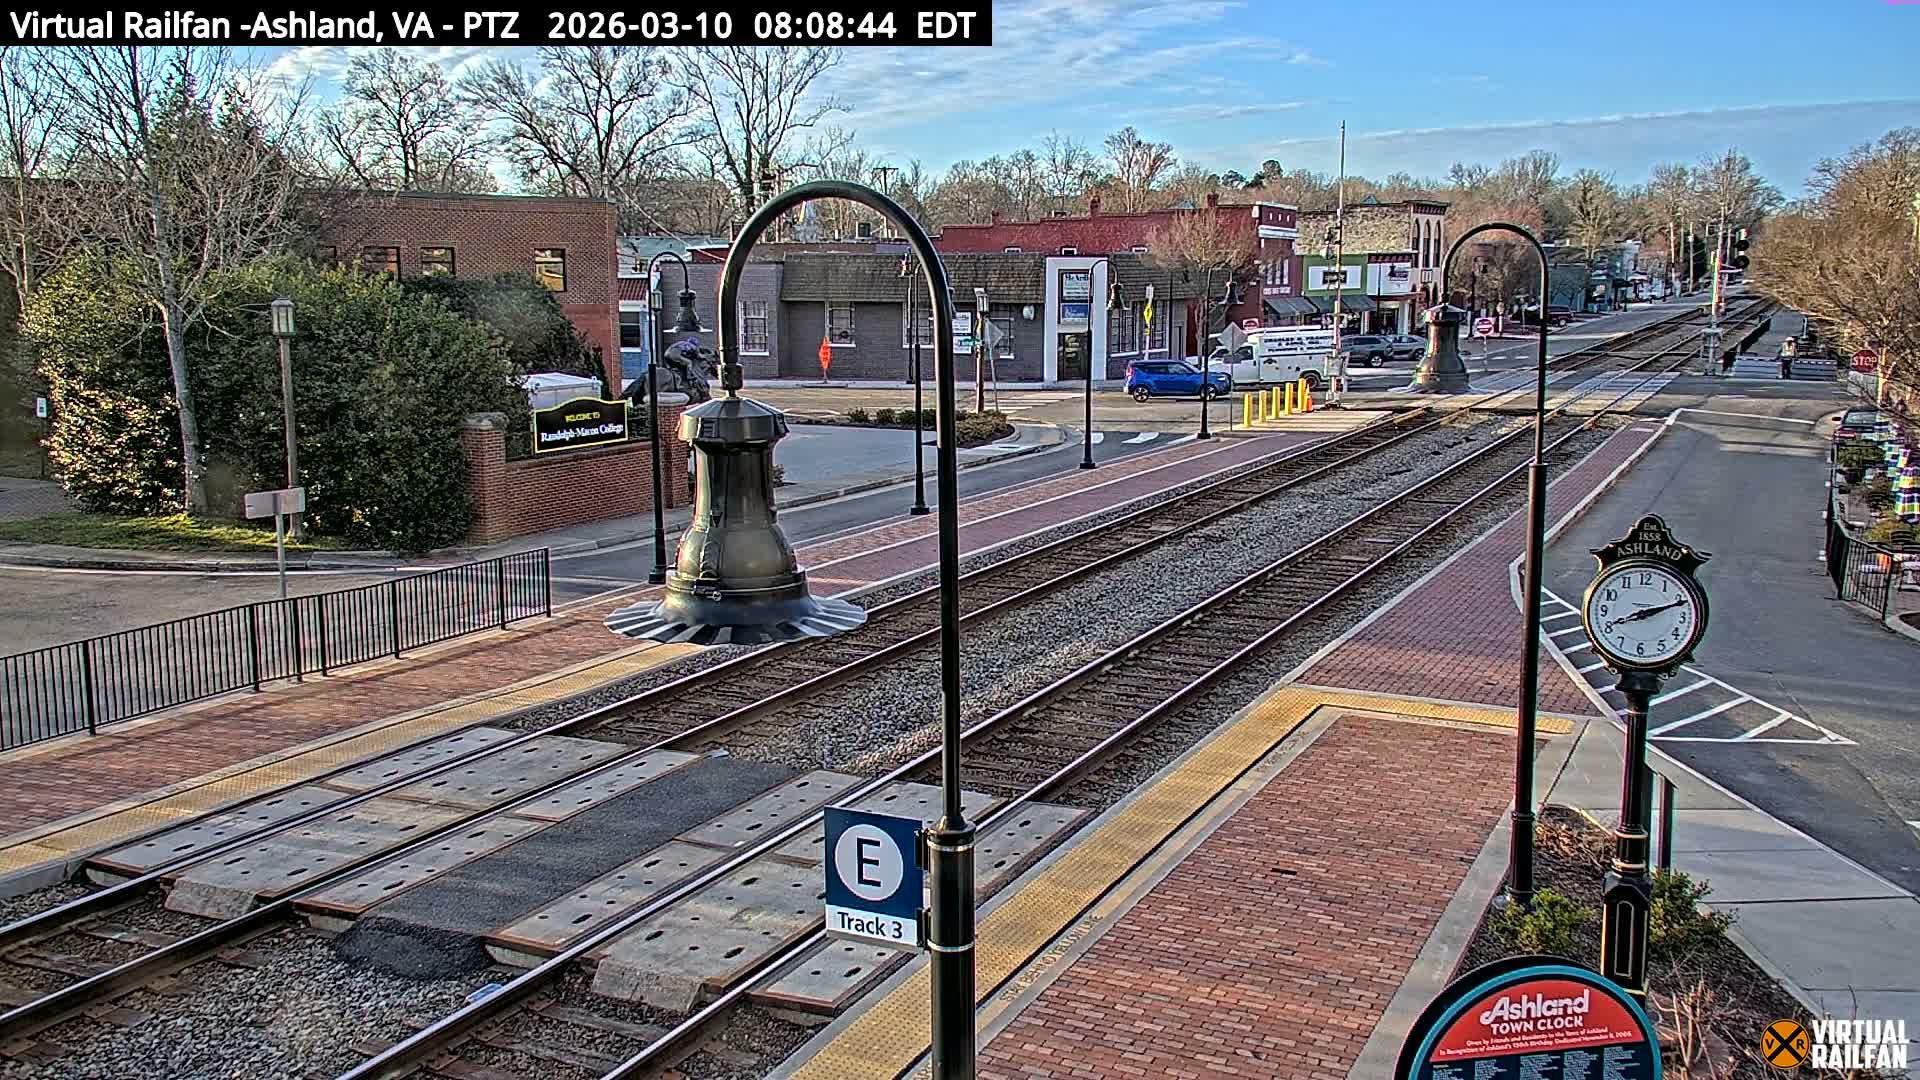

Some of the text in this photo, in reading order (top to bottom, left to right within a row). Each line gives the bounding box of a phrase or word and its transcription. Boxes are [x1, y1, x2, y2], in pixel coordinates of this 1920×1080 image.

[1853, 356, 1877, 368] STOP
[599, 423, 624, 434] College
[1639, 532, 1662, 542] 1858
[1617, 542, 1682, 560] ASHLAND
[1622, 577, 1632, 589] 11
[1640, 573, 1652, 585] 12
[1662, 580, 1667, 592] 1
[1606, 589, 1617, 602] 10
[1600, 605, 1608, 617] 9
[1679, 612, 1686, 624] 3
[1604, 622, 1613, 634] 8
[1672, 627, 1680, 640] 4
[1617, 636, 1625, 648] 7
[1657, 639, 1666, 652] 5
[1637, 642, 1644, 655] 6
[856, 837, 881, 887] E
[837, 911, 903, 939] Track 3
[1479, 989, 1590, 1025] Ashland
[1490, 1015, 1584, 1035] TOWN CLOCK
[1491, 1036, 1510, 1044] Friends
[1586, 1026, 1609, 1034] Ashland
